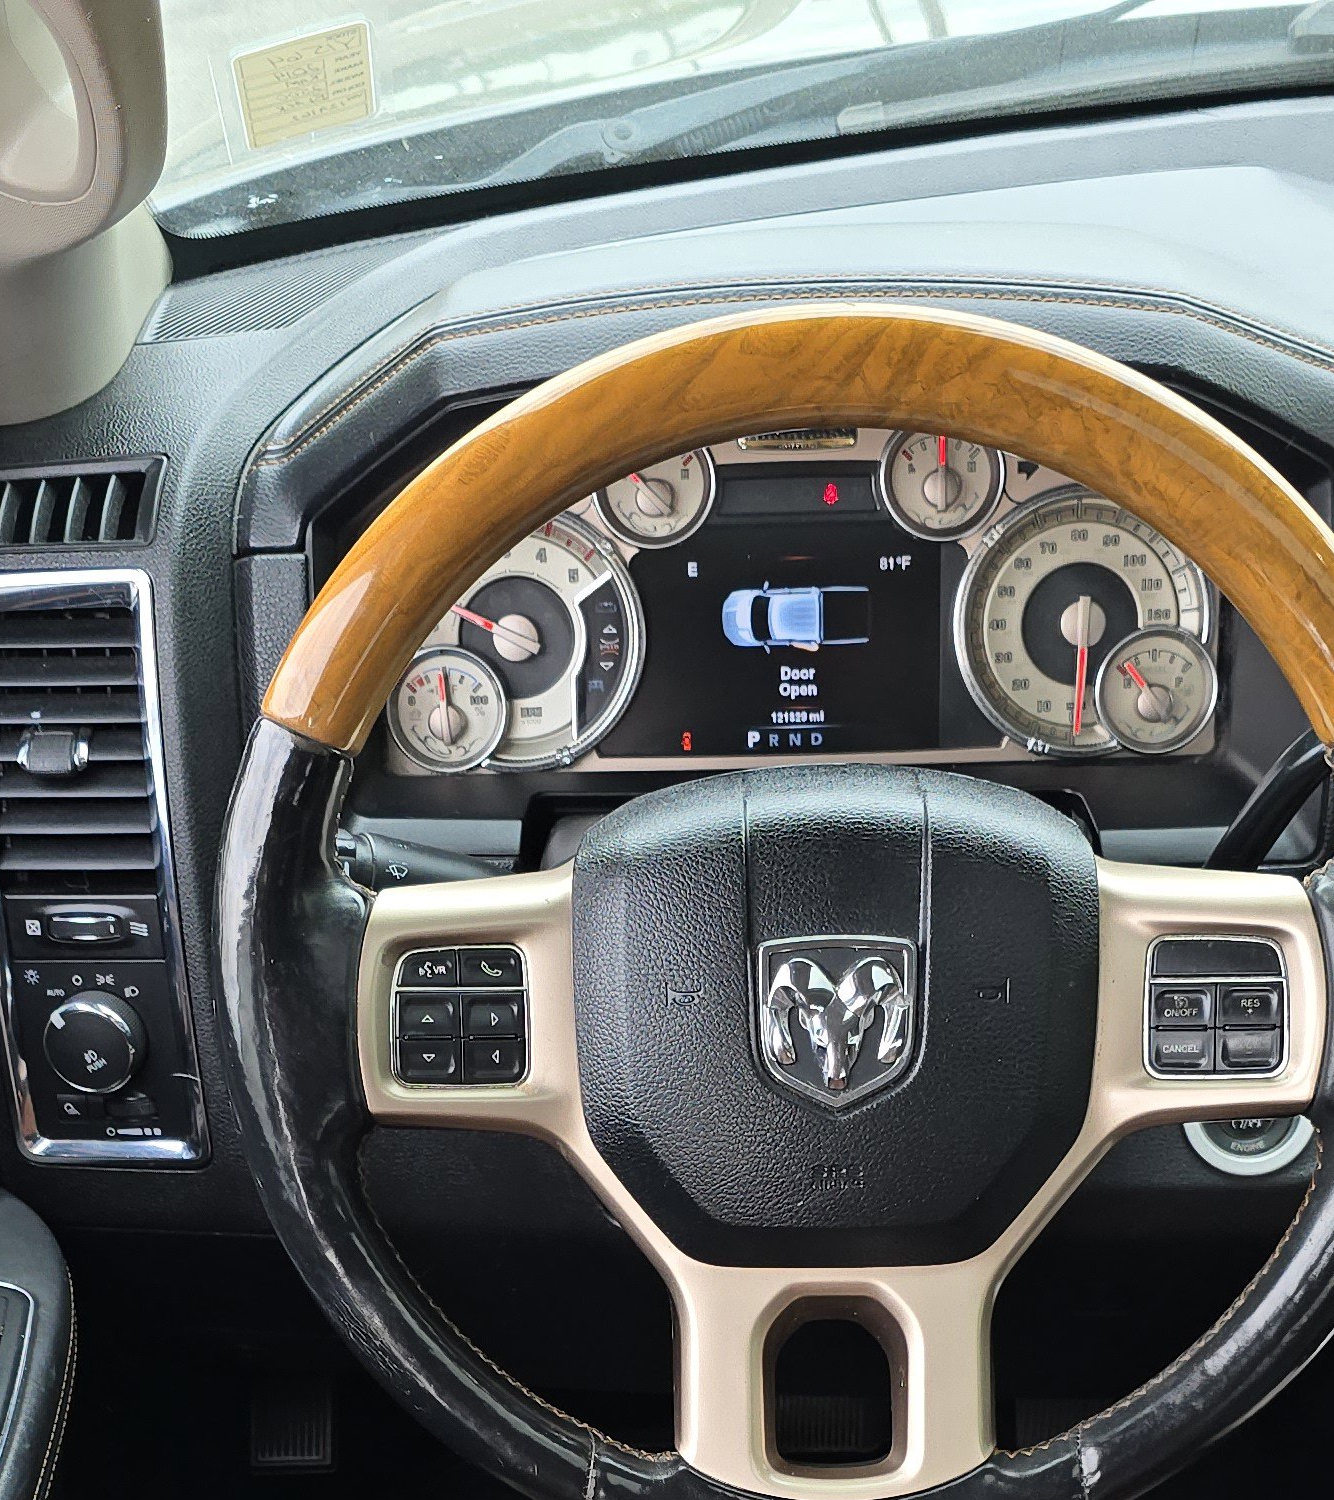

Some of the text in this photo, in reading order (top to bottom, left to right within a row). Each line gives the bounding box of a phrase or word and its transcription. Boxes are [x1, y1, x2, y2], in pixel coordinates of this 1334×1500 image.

[1040, 541, 1057, 554] 70
[535, 547, 548, 563] 4
[1123, 554, 1146, 567] 100
[688, 561, 698, 577] E
[1141, 578, 1162, 591] 110
[989, 619, 1007, 631] 40
[780, 666, 815, 680] Door
[779, 682, 818, 700] Open
[1037, 701, 1051, 713] 10
[747, 730, 822, 748] P R N D
[1240, 998, 1261, 1008] RES
[1164, 1007, 1199, 1017] ON/OFF
[1162, 1044, 1200, 1054] CANCEL
